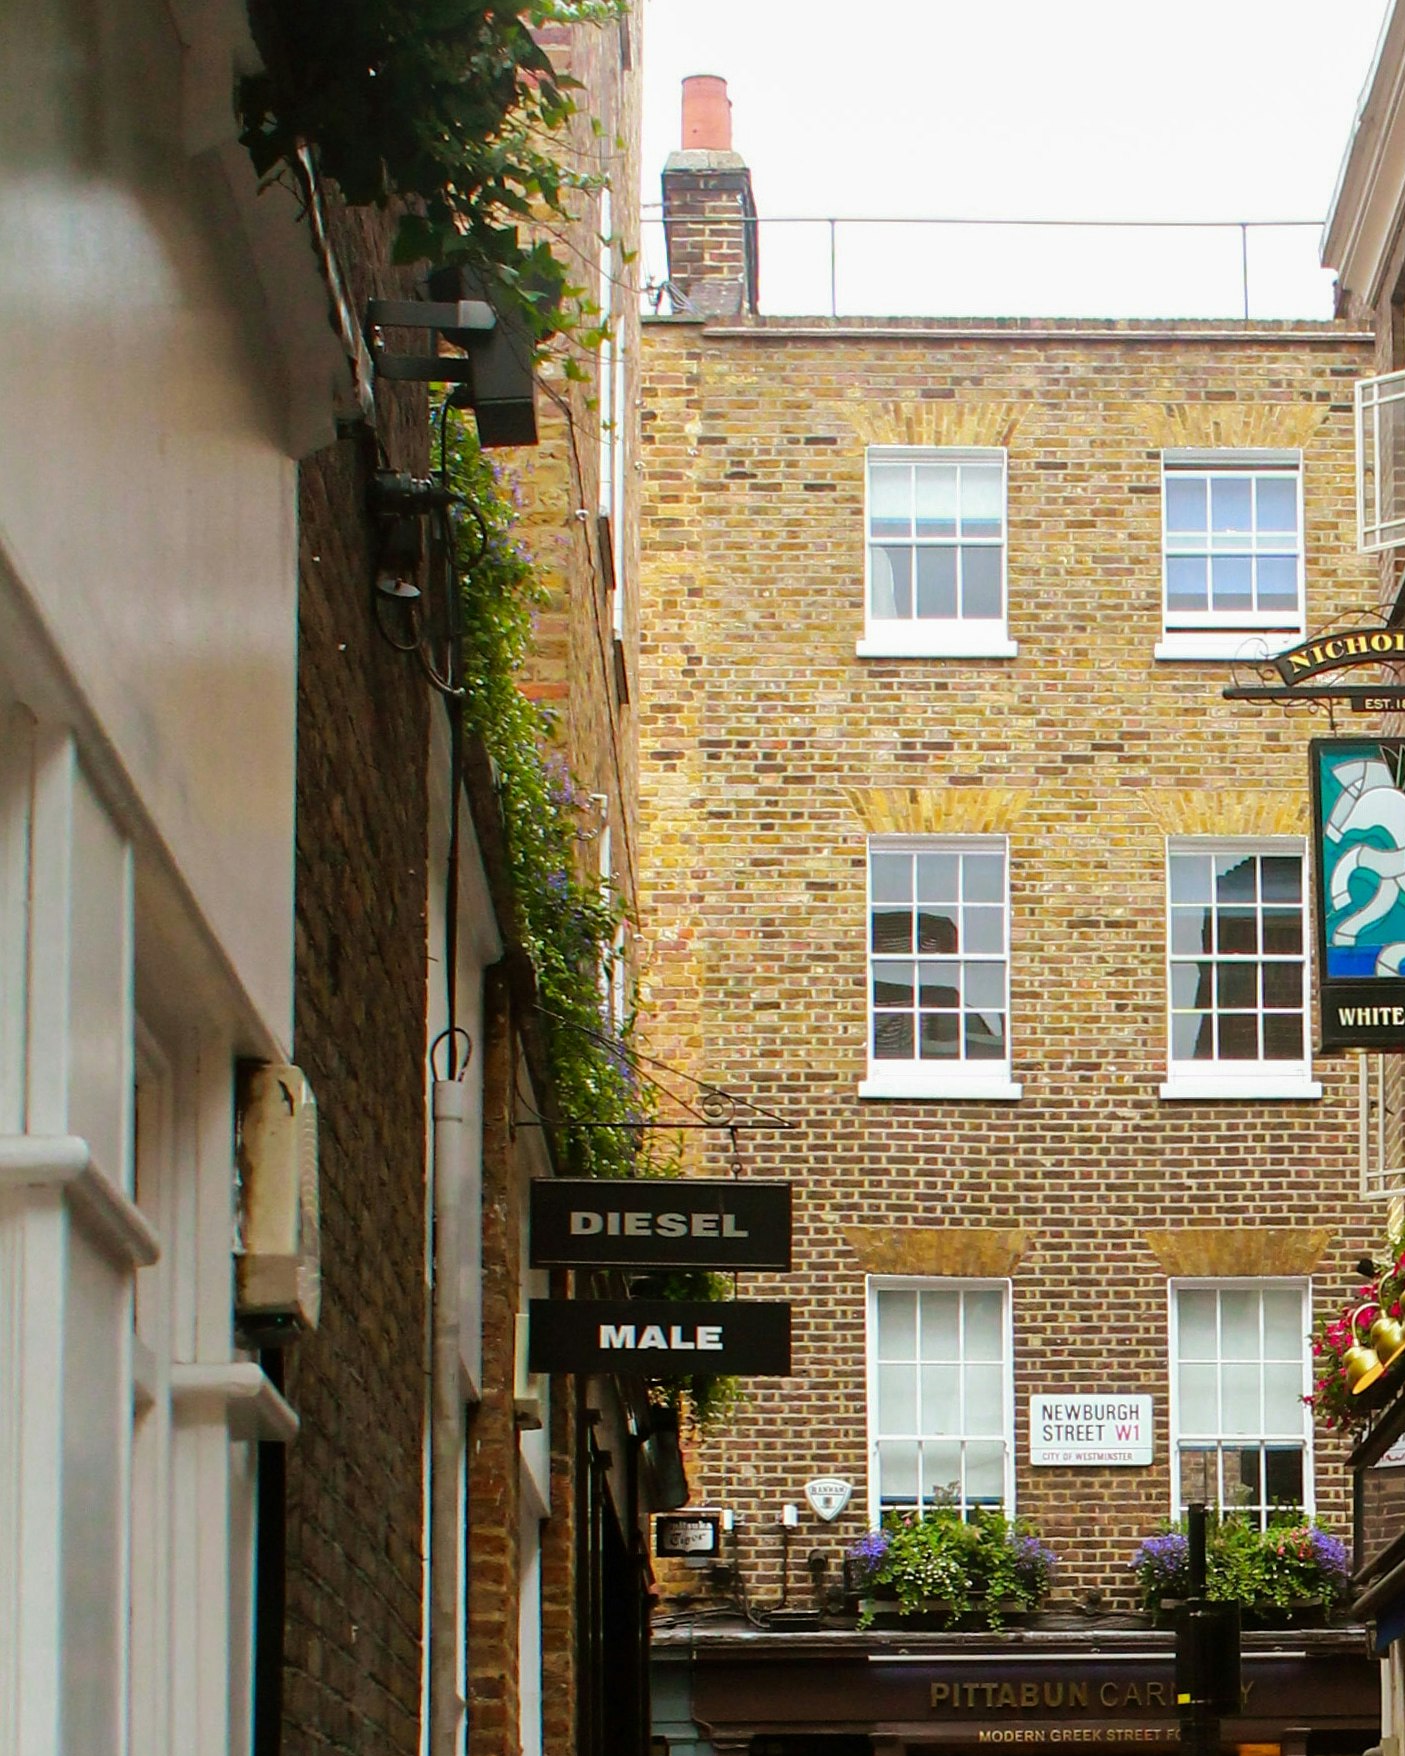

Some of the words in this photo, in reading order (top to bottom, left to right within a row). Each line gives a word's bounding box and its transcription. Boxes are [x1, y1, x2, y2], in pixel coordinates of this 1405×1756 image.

[1338, 1008, 1405, 1026] WHITE
[569, 1212, 749, 1239] DIESEL
[599, 1325, 723, 1351] MALE
[1042, 1404, 1139, 1420] NEWBURGH
[1042, 1424, 1105, 1441] STREET
[1115, 1425, 1139, 1440] W1
[1043, 1453, 1059, 1461] CITY
[1063, 1453, 1072, 1461] OF
[1076, 1453, 1132, 1461] WESTMINSTER
[930, 1683, 1088, 1708] PITTABUN
[979, 1730, 1046, 1742] MODERN
[1050, 1729, 1101, 1742] GREEK
[1106, 1729, 1161, 1741] STREET
